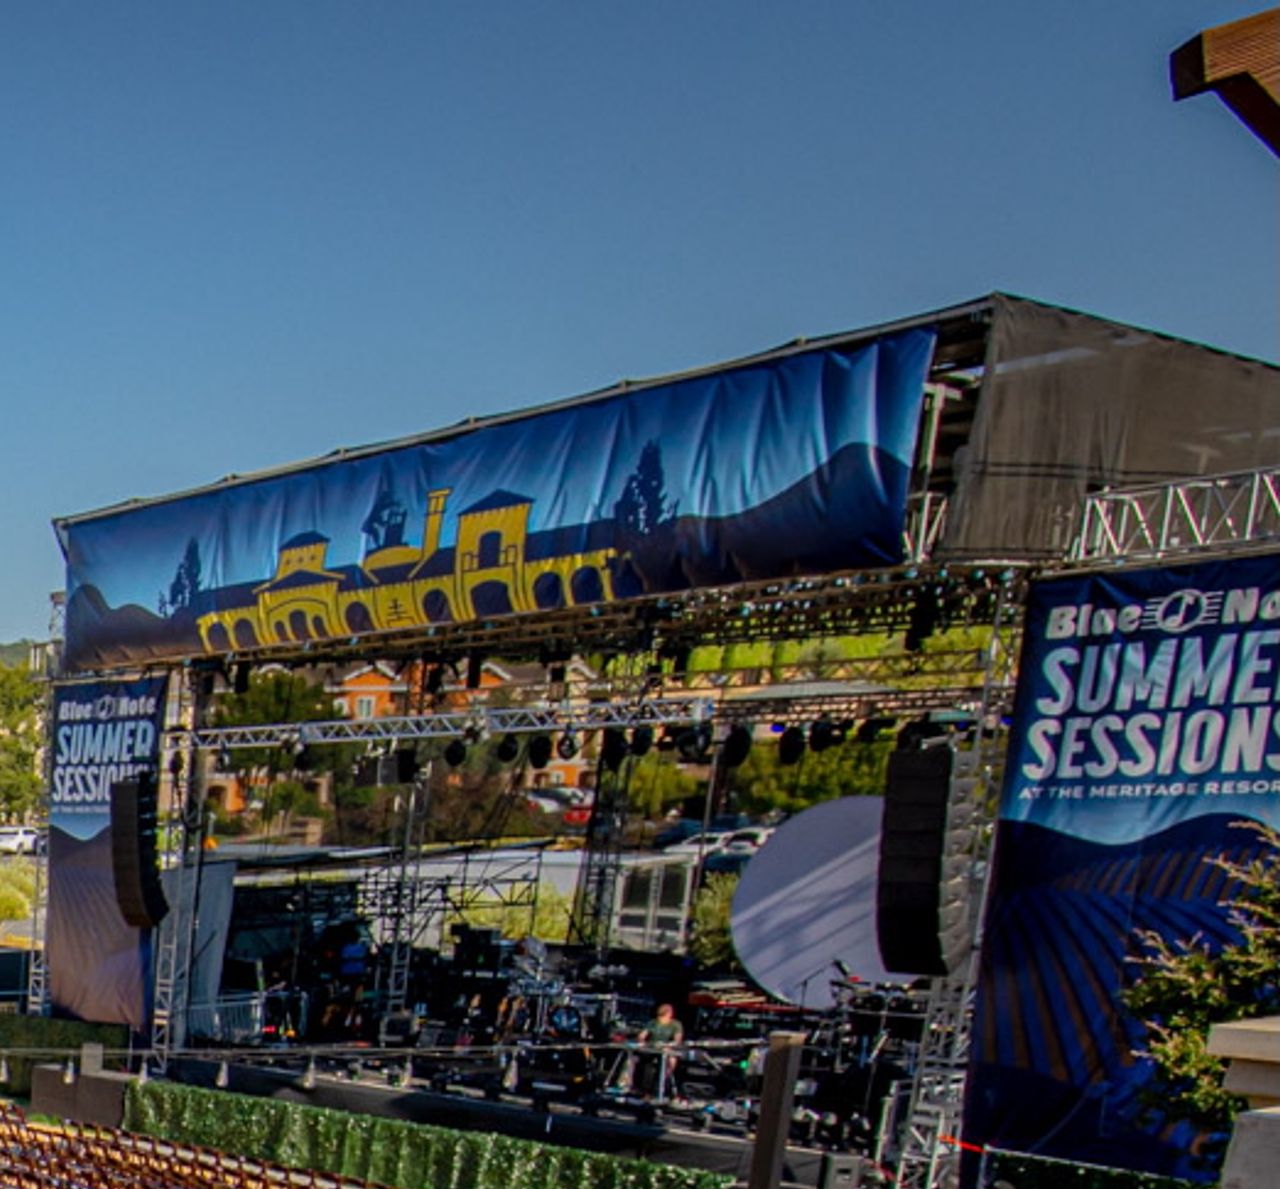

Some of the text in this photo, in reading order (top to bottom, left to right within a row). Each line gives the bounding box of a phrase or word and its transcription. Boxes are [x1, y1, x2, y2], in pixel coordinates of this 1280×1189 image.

[1044, 603, 1143, 640] Blue
[1035, 629, 1280, 716] SUMME
[58, 696, 156, 720] Blue Note
[56, 720, 155, 764] SUMMER
[1018, 786, 1044, 799] AT
[1048, 785, 1084, 799] THE
[1089, 782, 1198, 799] MERITAGE
